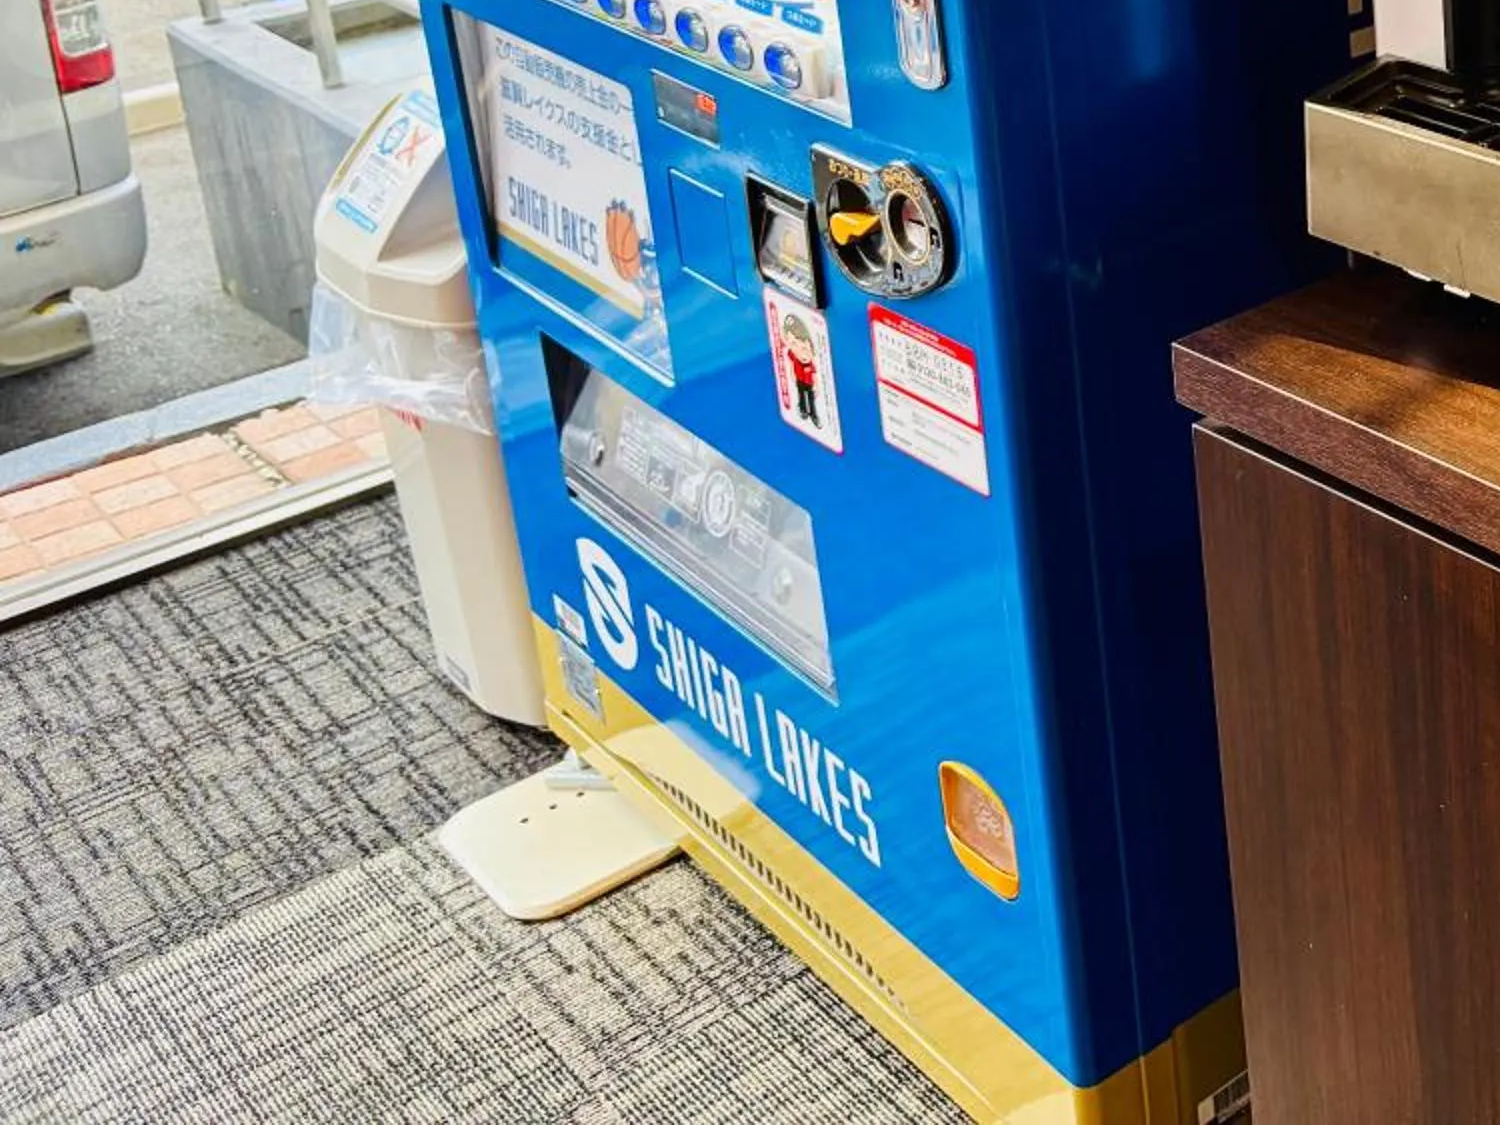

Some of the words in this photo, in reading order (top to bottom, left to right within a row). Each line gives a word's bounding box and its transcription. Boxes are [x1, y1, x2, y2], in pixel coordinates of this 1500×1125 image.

[550, 198, 600, 267] LAKES
[645, 602, 752, 758] SHIGA
[754, 692, 881, 869] LAKES
